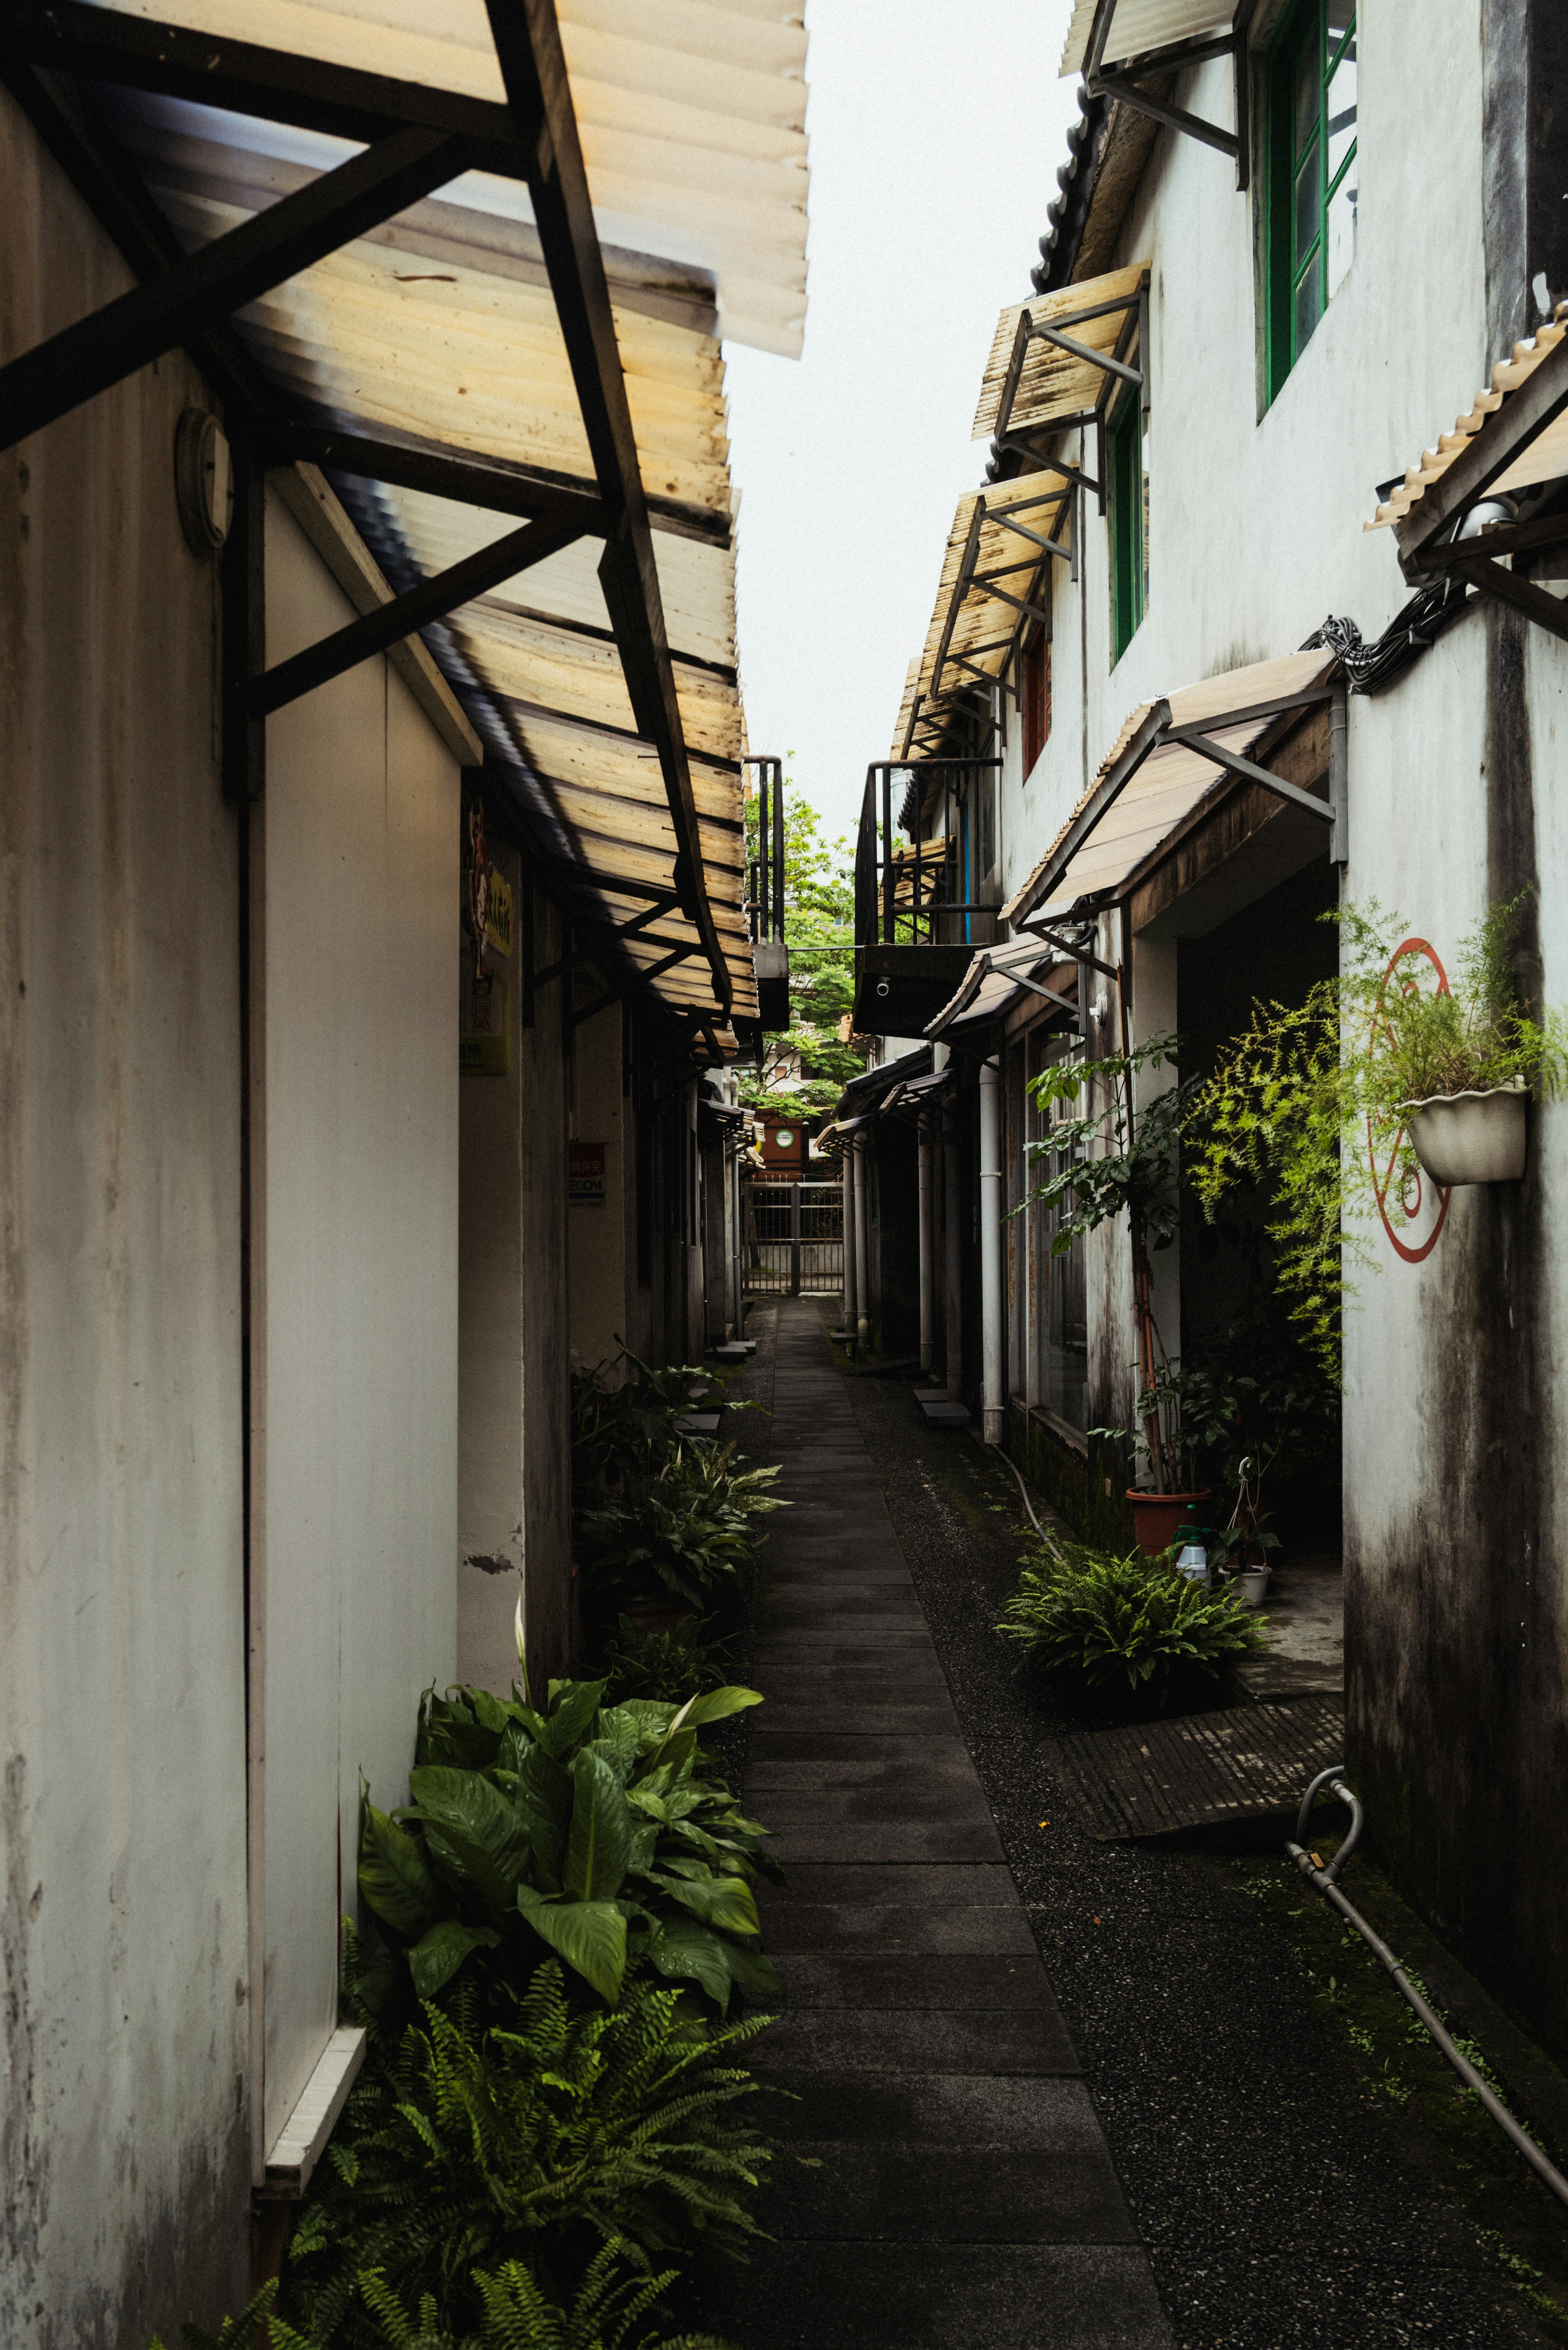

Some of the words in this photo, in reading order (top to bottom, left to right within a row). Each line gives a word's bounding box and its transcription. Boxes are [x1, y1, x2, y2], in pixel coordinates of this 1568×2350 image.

[568, 1161, 601, 1172] 興保全
[569, 1180, 601, 1190] ECOM
